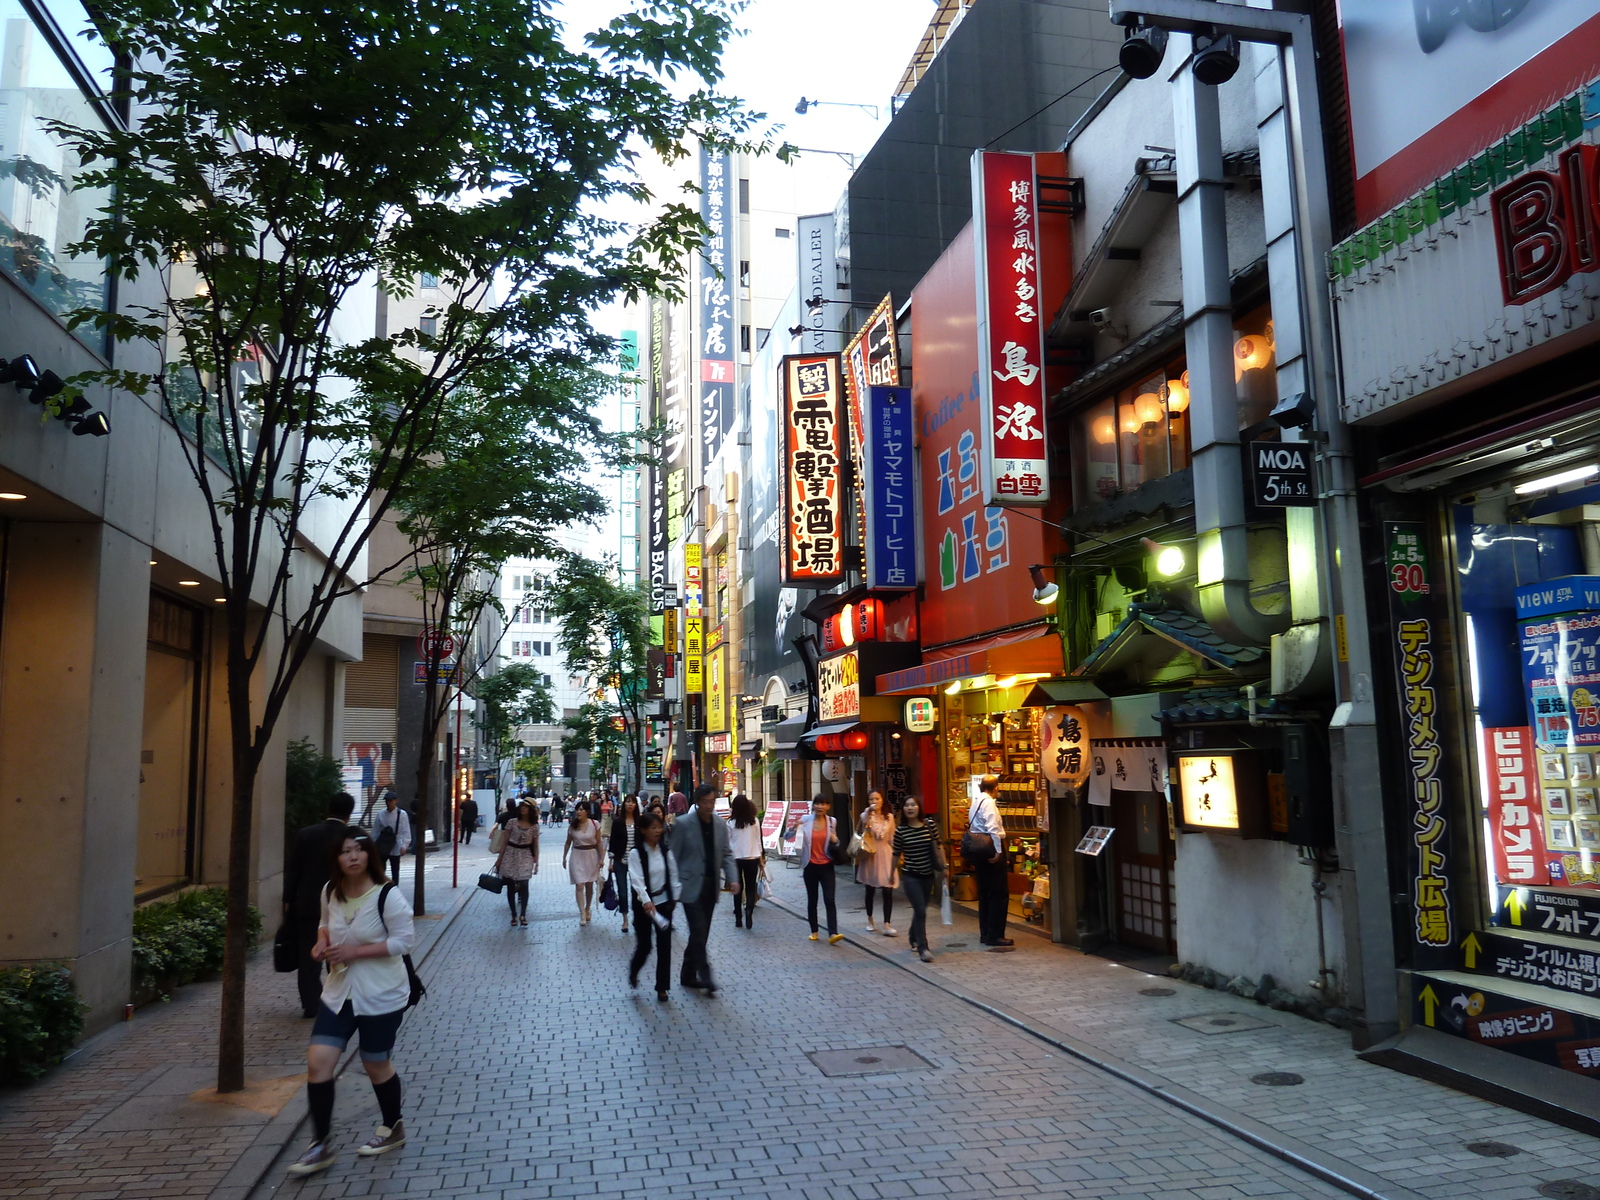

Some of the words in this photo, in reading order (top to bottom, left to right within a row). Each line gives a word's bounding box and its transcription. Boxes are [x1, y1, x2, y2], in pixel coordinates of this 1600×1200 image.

[1490, 142, 1600, 307] BI
[922, 390, 964, 438] Coffee
[1259, 449, 1305, 470] MOA
[792, 398, 834, 572] 電撃酒場
[996, 473, 1046, 497] 白雪
[1263, 475, 1291, 502] 5th
[883, 440, 906, 584] ヤマモトコーヒー店
[651, 550, 664, 612] BAGUS
[1556, 587, 1573, 596] ATM
[688, 618, 701, 674] 大黒屋
[1522, 636, 1600, 666] フォトブッ
[665, 655, 675, 678] BAR
[1545, 660, 1596, 676] スエア
[1397, 618, 1451, 947] デジカメプリント広場
[1493, 731, 1535, 879] ビックカメラ
[1534, 893, 1580, 908] FUJICOLOR
[1523, 943, 1600, 974] フィルム現
[1496, 956, 1600, 993] デジカメお店プ
[1478, 1010, 1554, 1039] 映像ダビング
